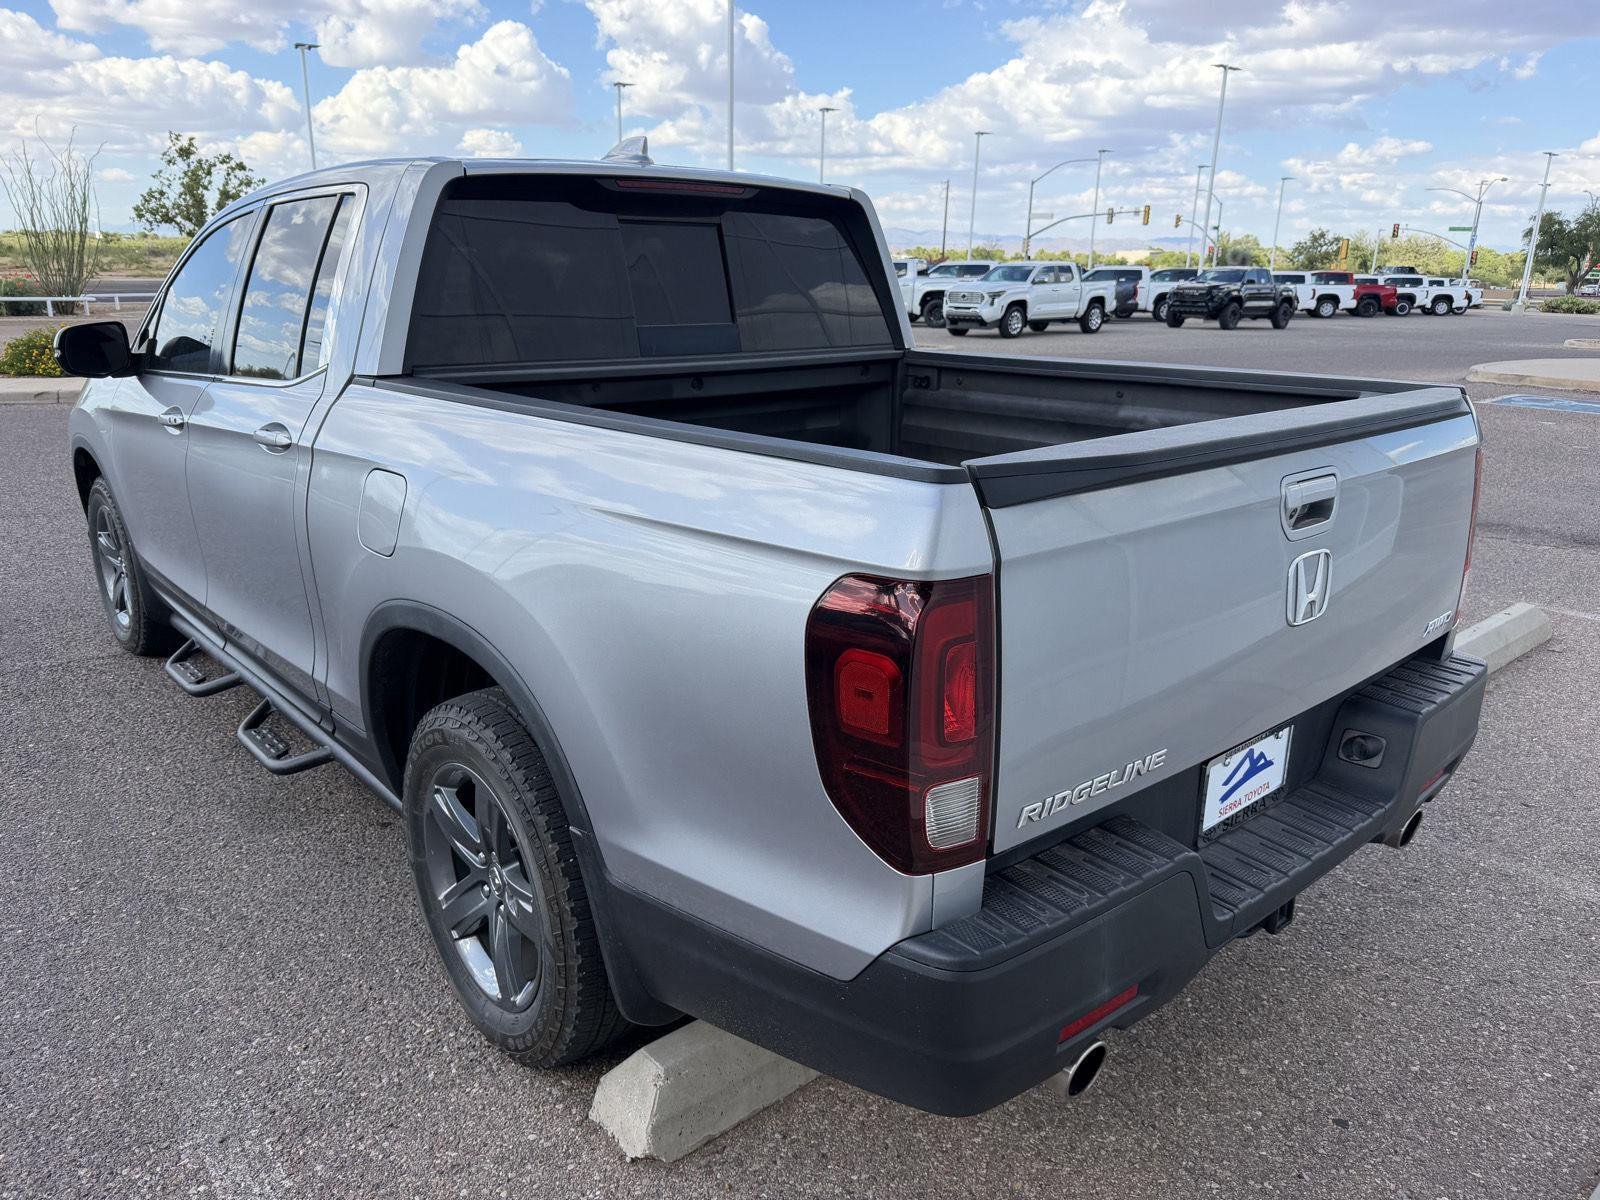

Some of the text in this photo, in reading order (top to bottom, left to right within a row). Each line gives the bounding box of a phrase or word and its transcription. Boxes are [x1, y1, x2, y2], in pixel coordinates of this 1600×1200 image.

[1016, 748, 1168, 829] RIDGELINE
[1218, 797, 1242, 818] SIERRA
[1244, 781, 1270, 802] TOYOTA
[1222, 797, 1267, 833] SIERRA
